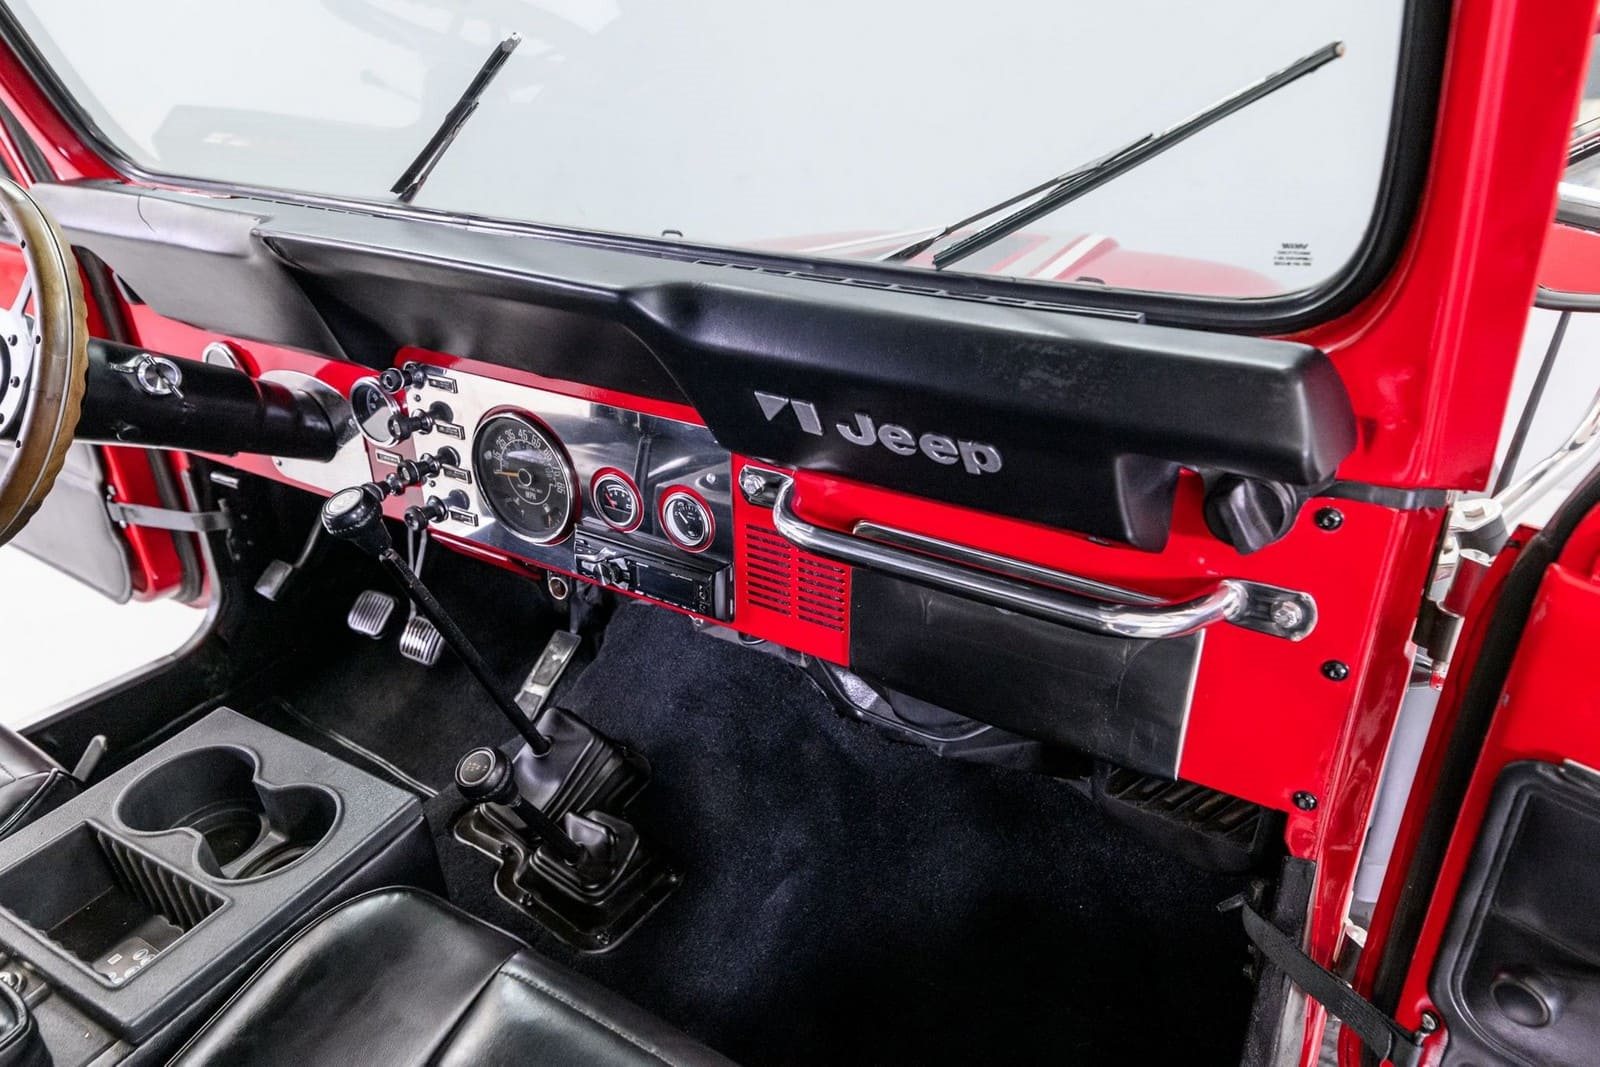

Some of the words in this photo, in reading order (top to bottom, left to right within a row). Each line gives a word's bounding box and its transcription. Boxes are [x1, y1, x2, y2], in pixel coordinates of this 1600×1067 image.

[505, 429, 516, 440] 35
[518, 429, 528, 441] 45
[836, 413, 1002, 475] Jeep
